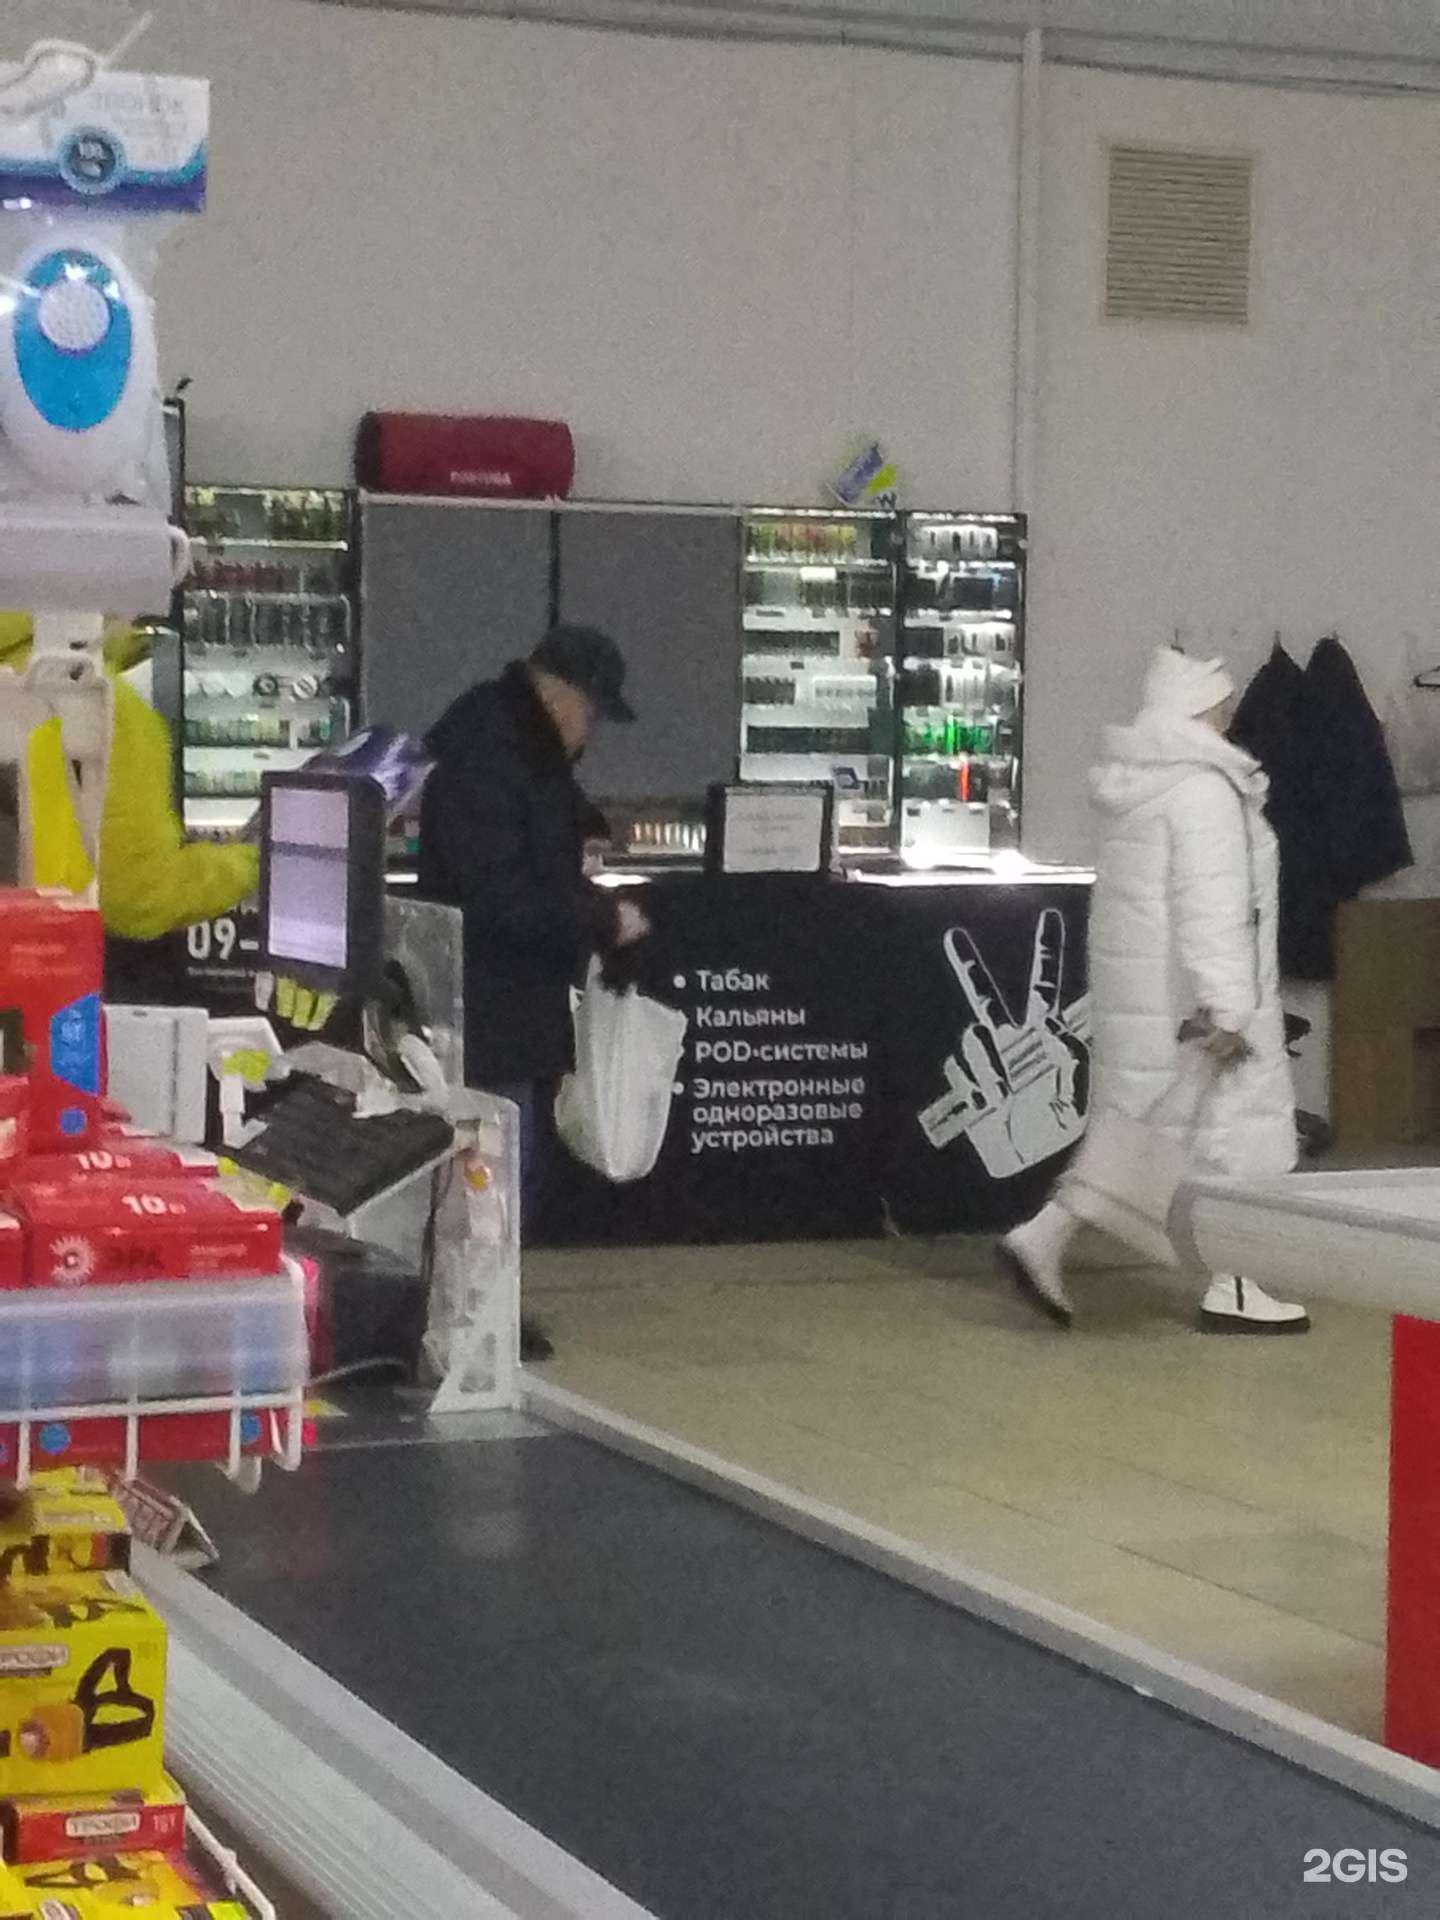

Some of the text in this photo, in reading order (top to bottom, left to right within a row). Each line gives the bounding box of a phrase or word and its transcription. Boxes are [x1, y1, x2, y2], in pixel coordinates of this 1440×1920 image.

[696, 968, 770, 991] Табак
[696, 1006, 806, 1028] Кальяны
[695, 1040, 869, 1062] POD-системы
[693, 1077, 866, 1101] Электронные
[692, 1102, 864, 1126] одноразовые
[690, 1124, 835, 1154] устройства
